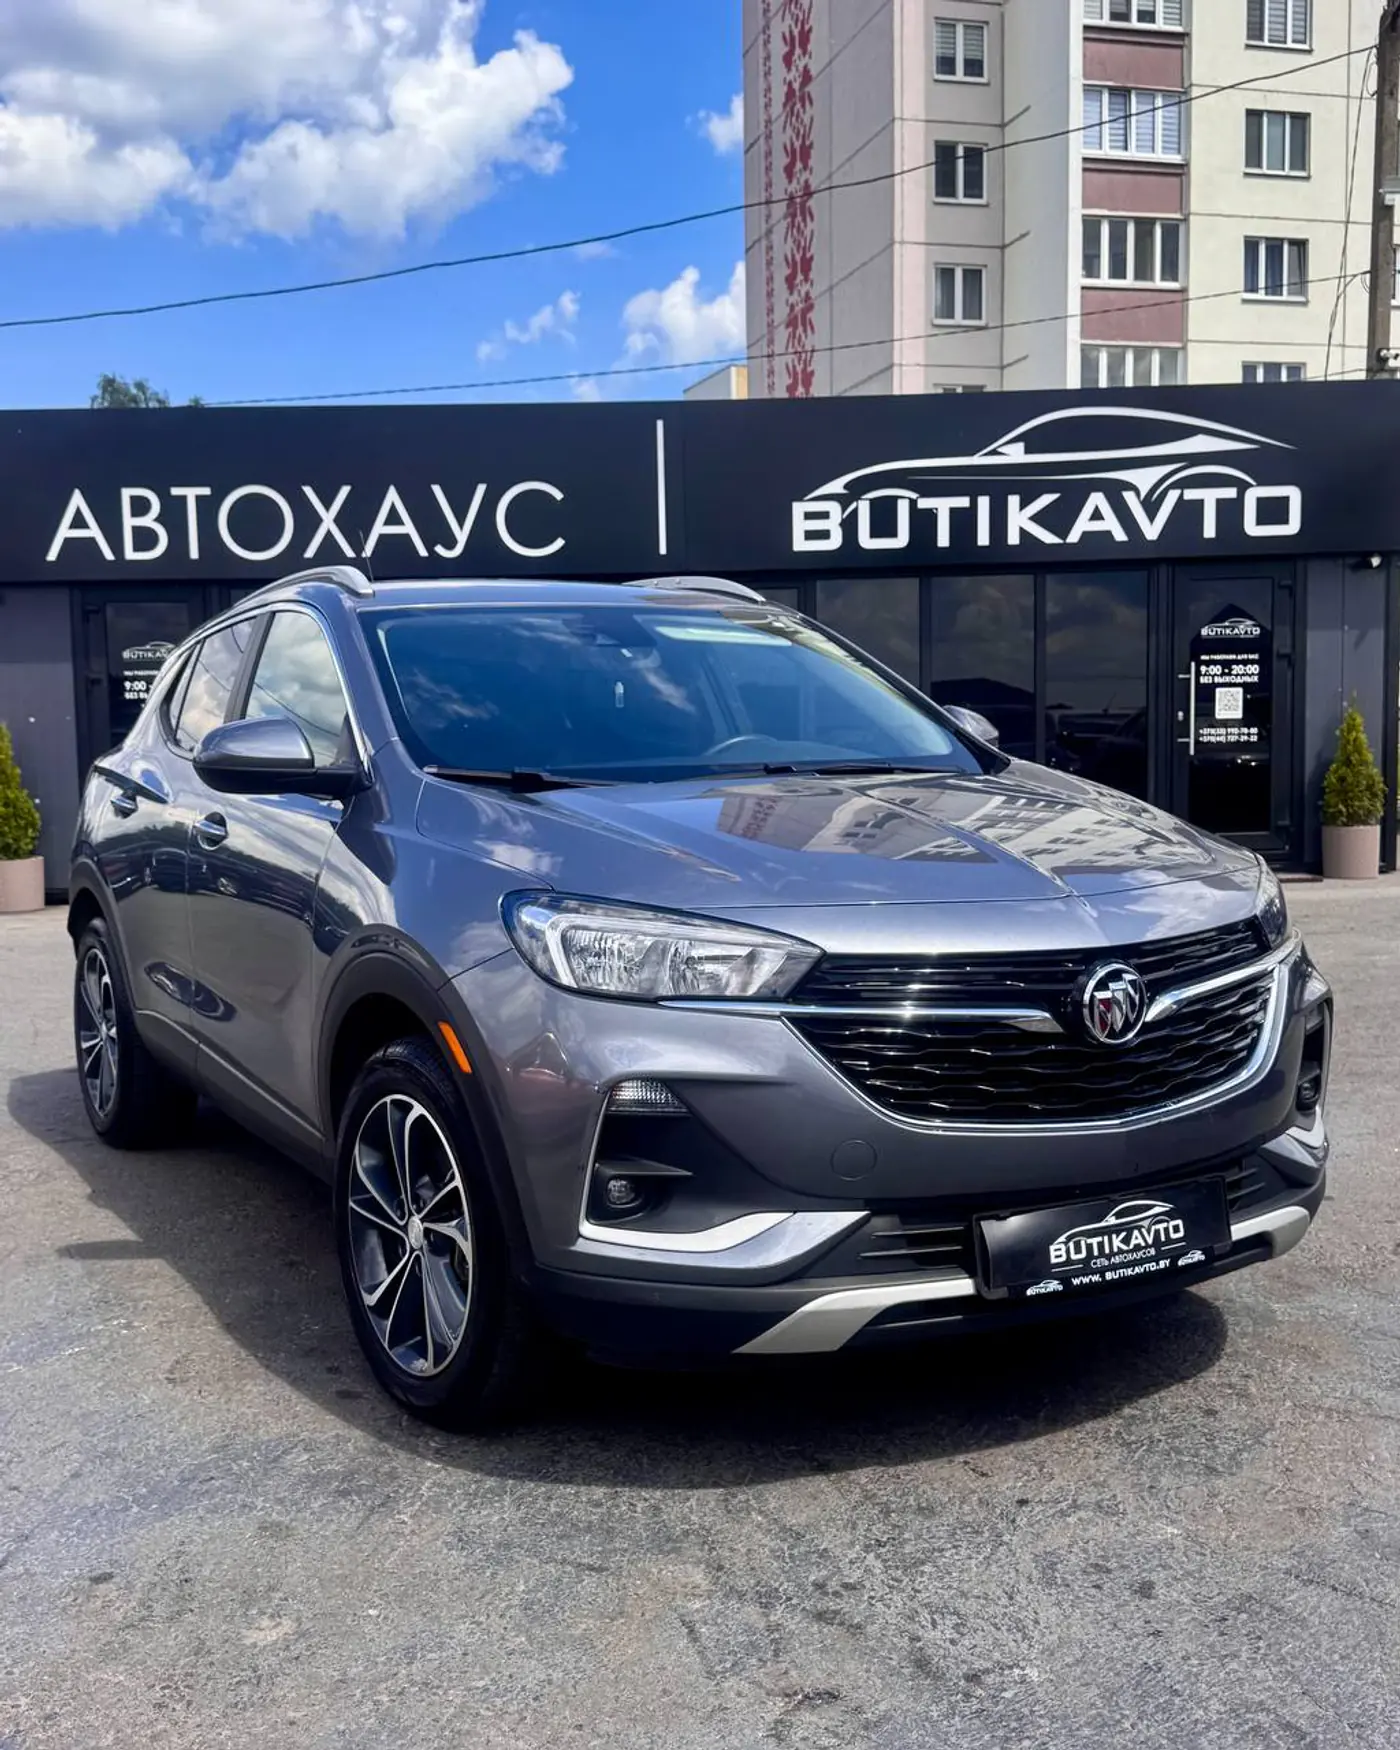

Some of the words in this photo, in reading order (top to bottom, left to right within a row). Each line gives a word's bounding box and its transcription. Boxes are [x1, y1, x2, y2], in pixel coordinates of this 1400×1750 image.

[45, 481, 566, 561] АВТОХАУС
[791, 484, 1302, 552] BUTIKAVTO
[1200, 626, 1260, 636] BUTIKAVTO
[122, 650, 169, 659] BUTIKAV
[1200, 665, 1222, 675] 9:00
[1231, 664, 1260, 675] 20:00
[123, 681, 147, 691] 9:00
[1050, 1219, 1185, 1264] BUTIKAVTO
[1091, 1257, 1109, 1269] СЕТЬ
[1110, 1247, 1156, 1265] АВТОХАУСОВ
[1071, 1273, 1102, 1286] WWW.
[1105, 1258, 1170, 1281] BUTIKAVTO.BY
